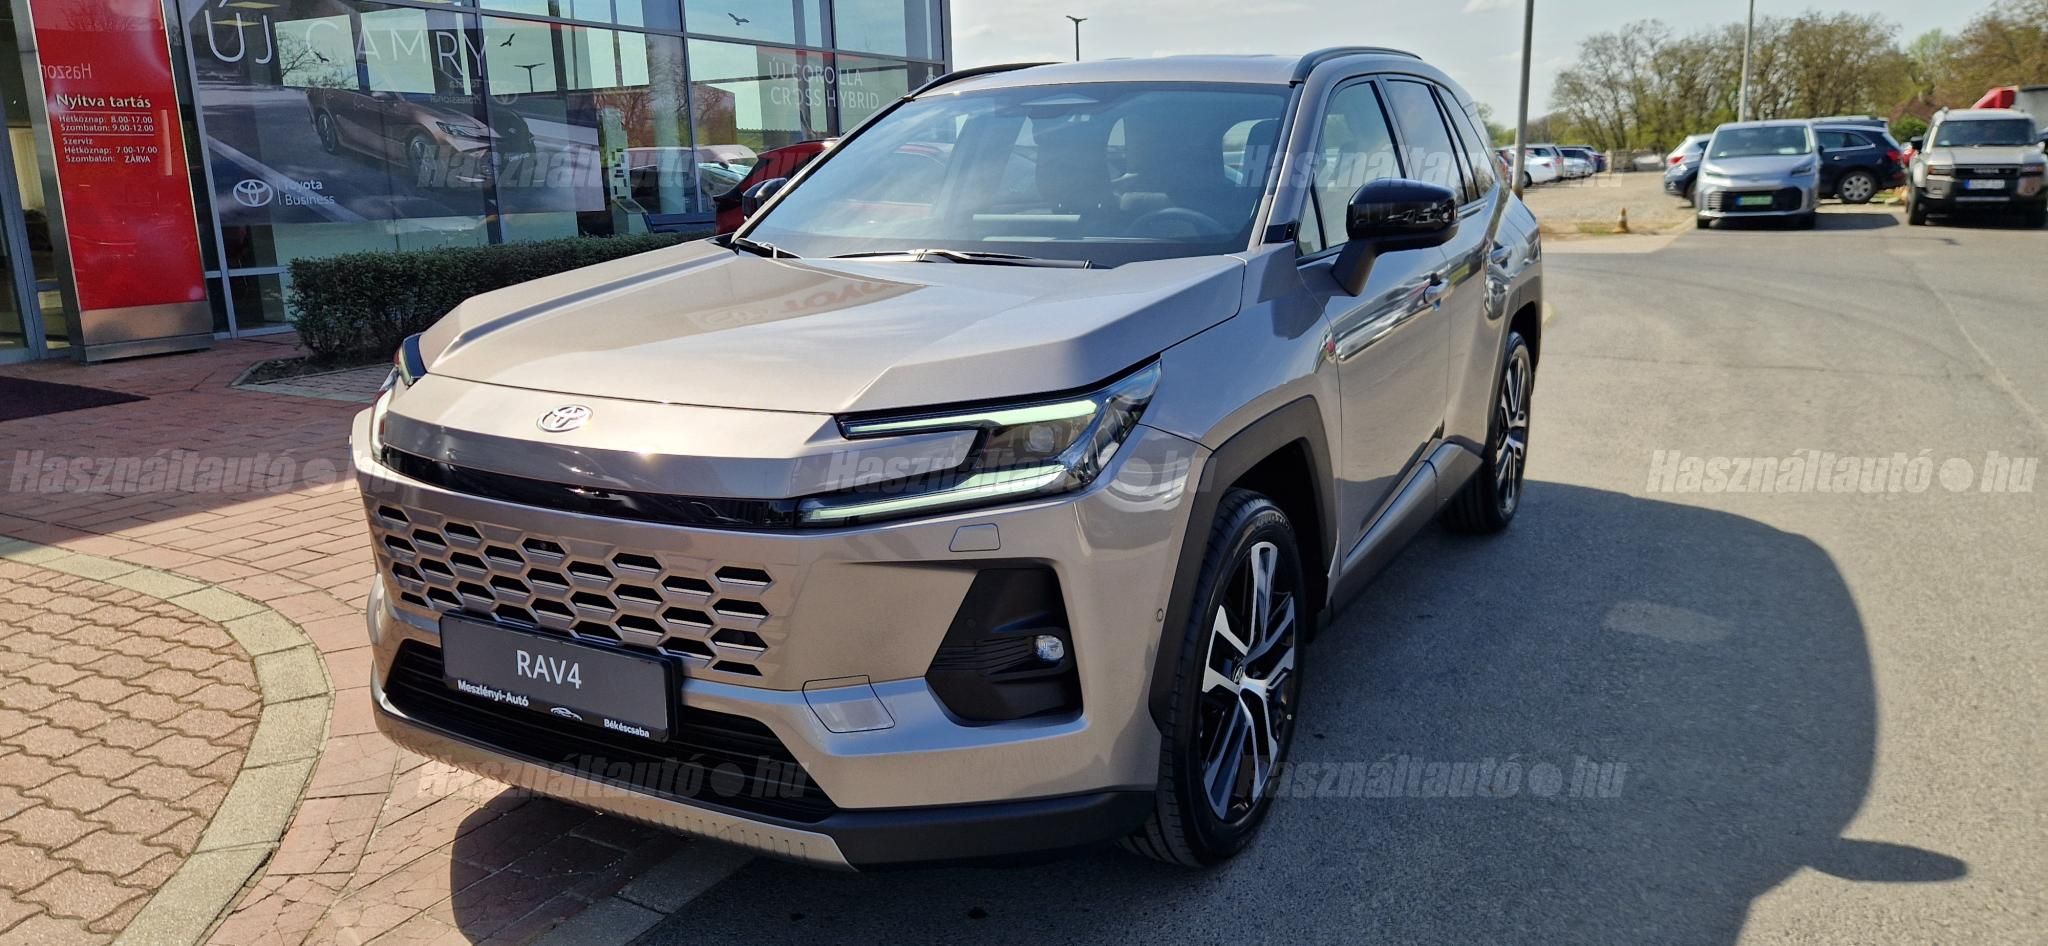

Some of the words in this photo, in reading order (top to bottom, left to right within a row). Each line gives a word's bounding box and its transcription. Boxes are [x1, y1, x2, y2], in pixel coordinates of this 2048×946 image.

[305, 19, 489, 77] CAMRY
[792, 63, 863, 86] COROLLA
[56, 94, 105, 110] Nyitva
[110, 95, 151, 108] tartás
[770, 86, 822, 108] CROSS
[826, 90, 880, 110] HYBRID
[59, 115, 106, 124] Hétköznap:
[60, 124, 110, 132] Szombaton:
[112, 124, 154, 132] 9.00-12.00
[63, 137, 93, 145] Szerviz
[64, 146, 112, 155] Hétköznap:
[116, 146, 158, 154] 7.00-17.00
[66, 155, 114, 163] Szombaton:
[125, 155, 151, 163] ZÁRVA
[285, 179, 323, 192] Toyota
[285, 194, 335, 206] Business
[516, 650, 582, 689] RAV4
[457, 679, 529, 707] Meszlényi-Autó
[603, 718, 650, 738] Békéscsaba
